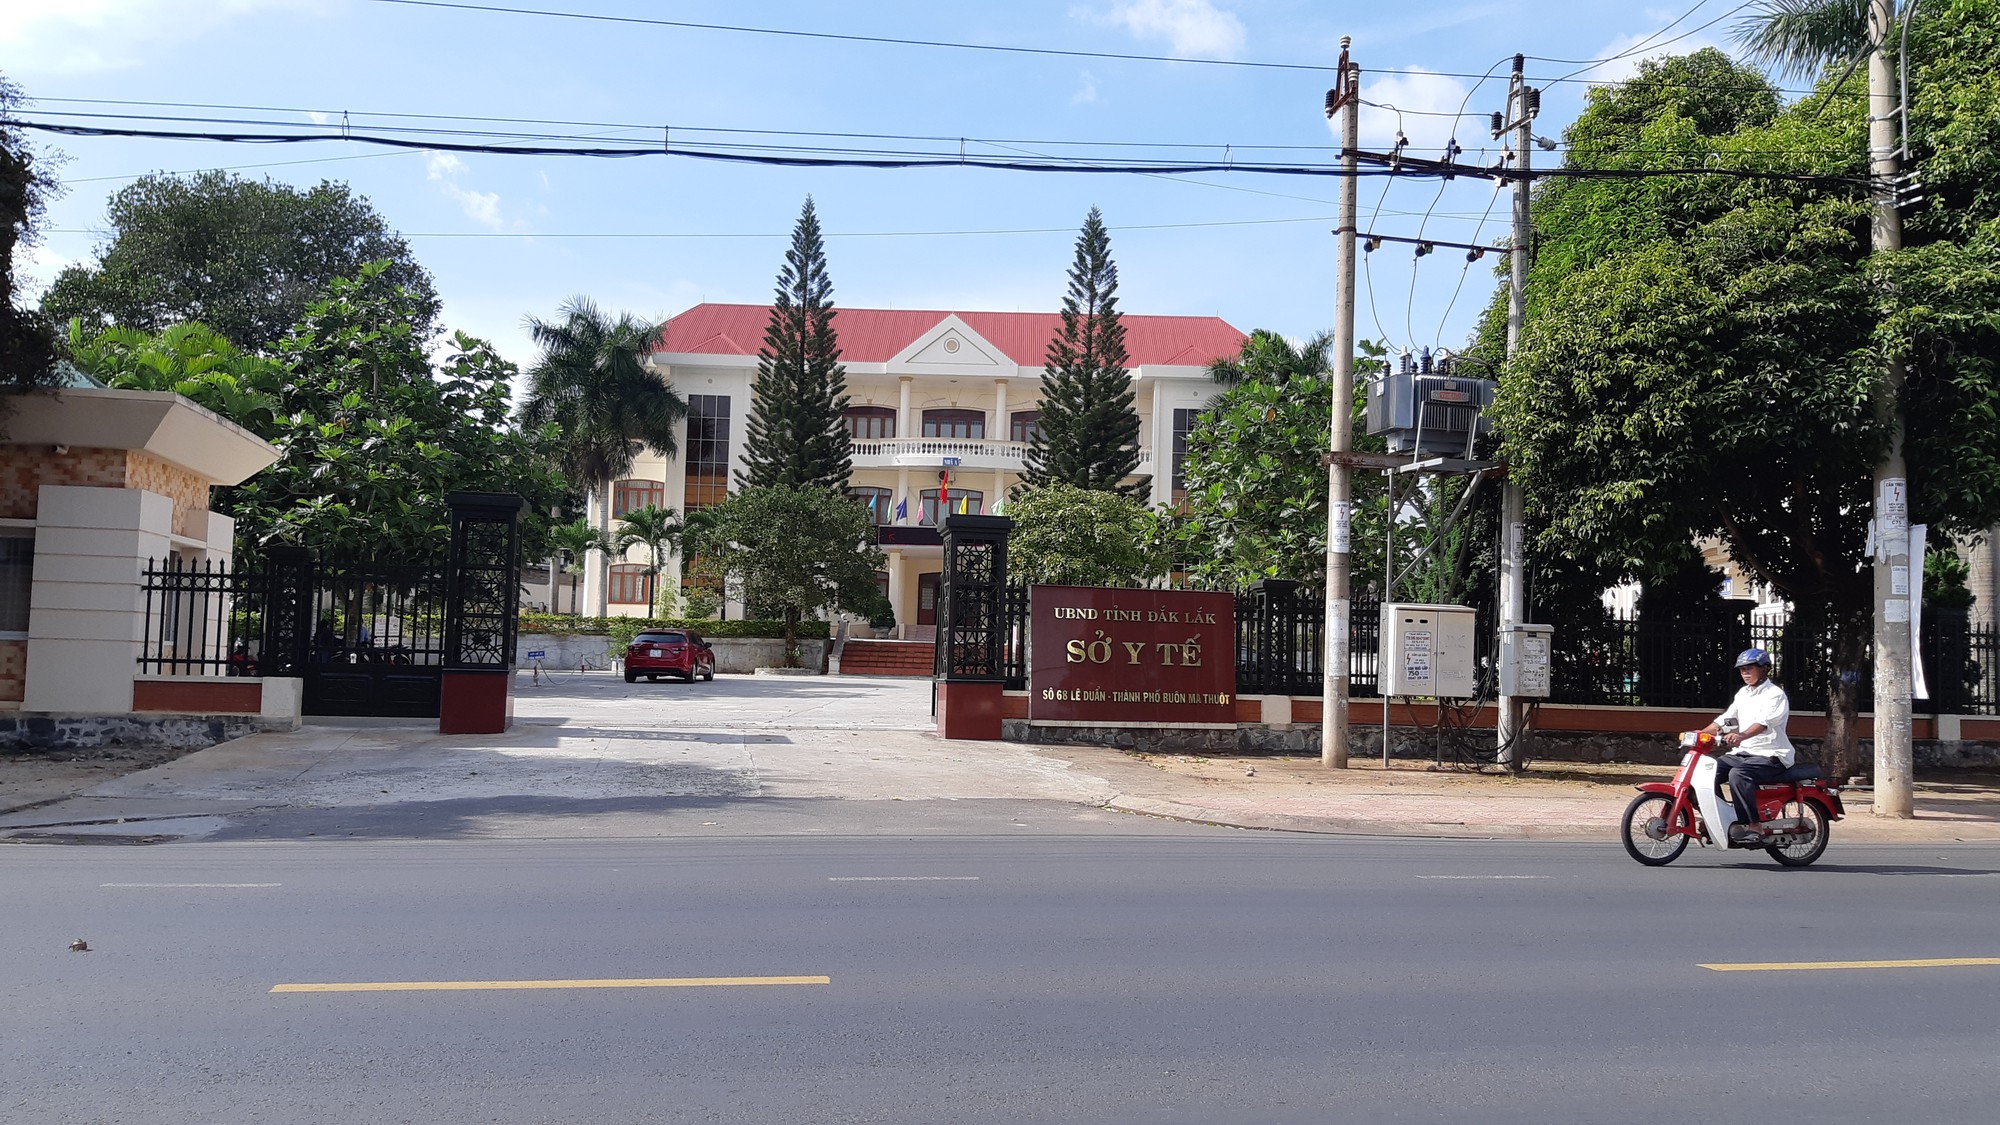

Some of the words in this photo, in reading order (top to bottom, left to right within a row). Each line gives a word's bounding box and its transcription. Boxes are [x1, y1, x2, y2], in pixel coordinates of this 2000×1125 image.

[1054, 607, 1098, 620] UBND
[1103, 605, 1142, 621] TỈNH
[1148, 605, 1179, 623] ĐẮK
[1184, 607, 1216, 624] LẮK
[1066, 629, 1112, 664] SỞ
[1122, 642, 1146, 665] Y
[1157, 633, 1202, 667] TẾ
[1056, 690, 1068, 701] 68
[1070, 687, 1081, 701] LÊ
[1083, 686, 1106, 701] DUẨN
[1112, 689, 1140, 702] THÀNH
[1143, 689, 1161, 703] PHỐ
[1163, 690, 1186, 703] BUÔN
[1188, 693, 1201, 704] MA
[1203, 692, 1230, 707] THUỘT
